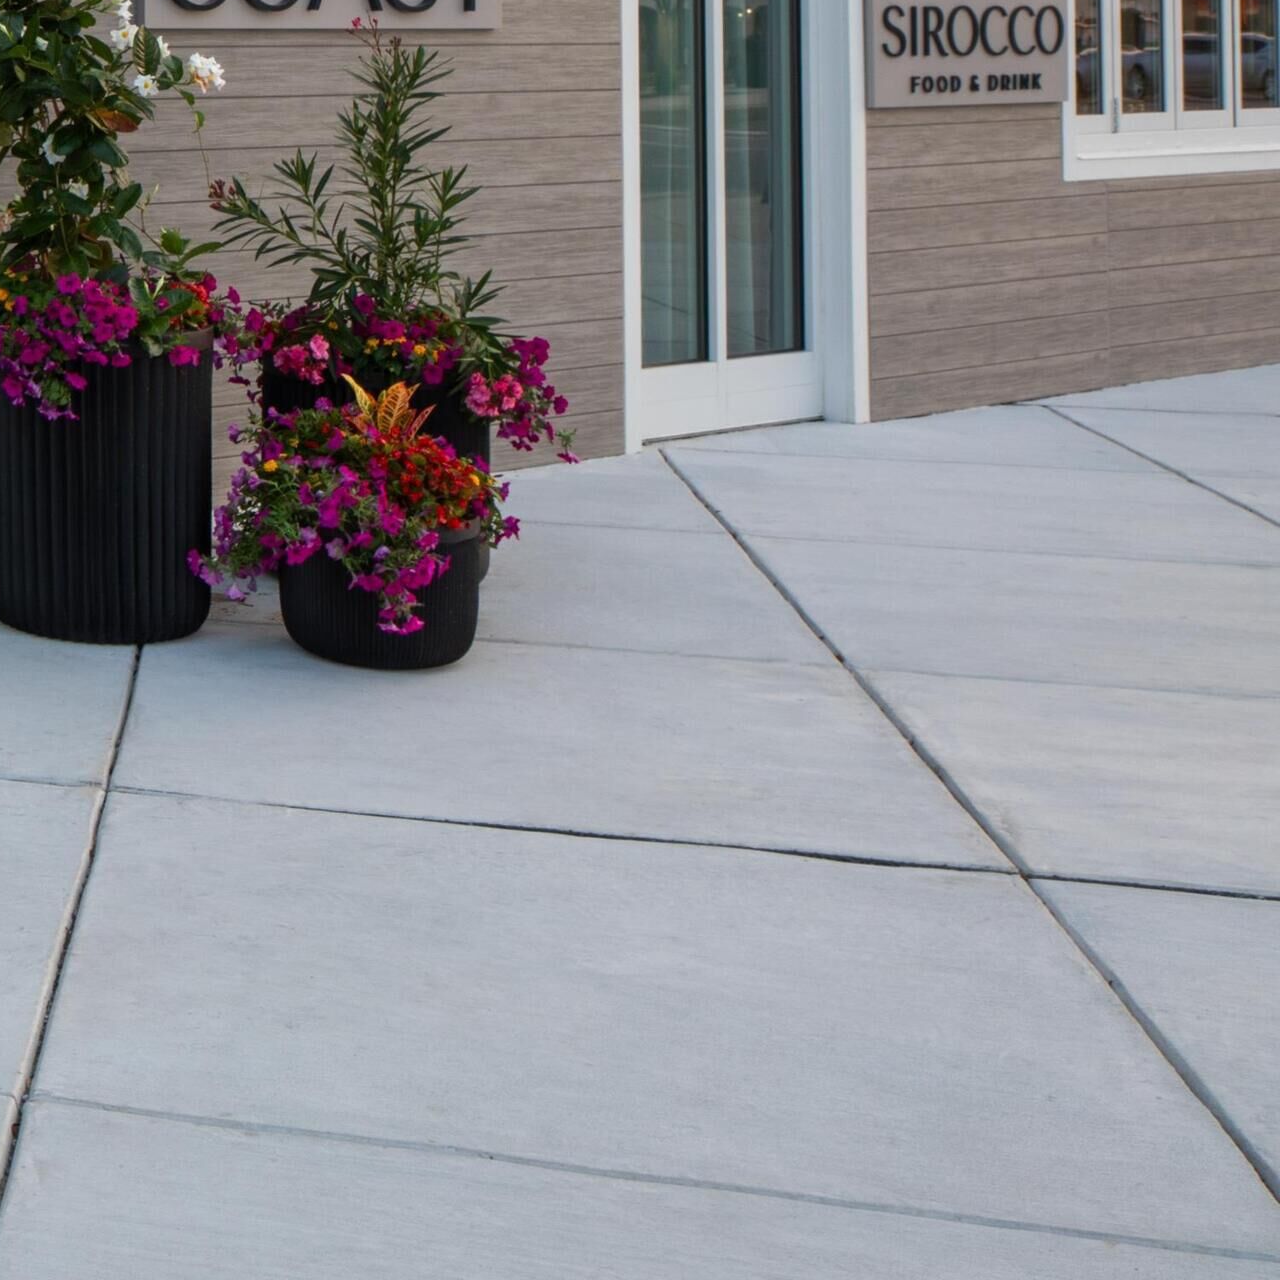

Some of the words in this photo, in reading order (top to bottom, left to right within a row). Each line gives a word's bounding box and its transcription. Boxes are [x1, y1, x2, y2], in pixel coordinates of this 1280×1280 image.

[881, 4, 1065, 58] SIROCCO
[910, 75, 961, 94] FOOD
[969, 75, 980, 92] &
[987, 73, 1042, 91] DRINK
